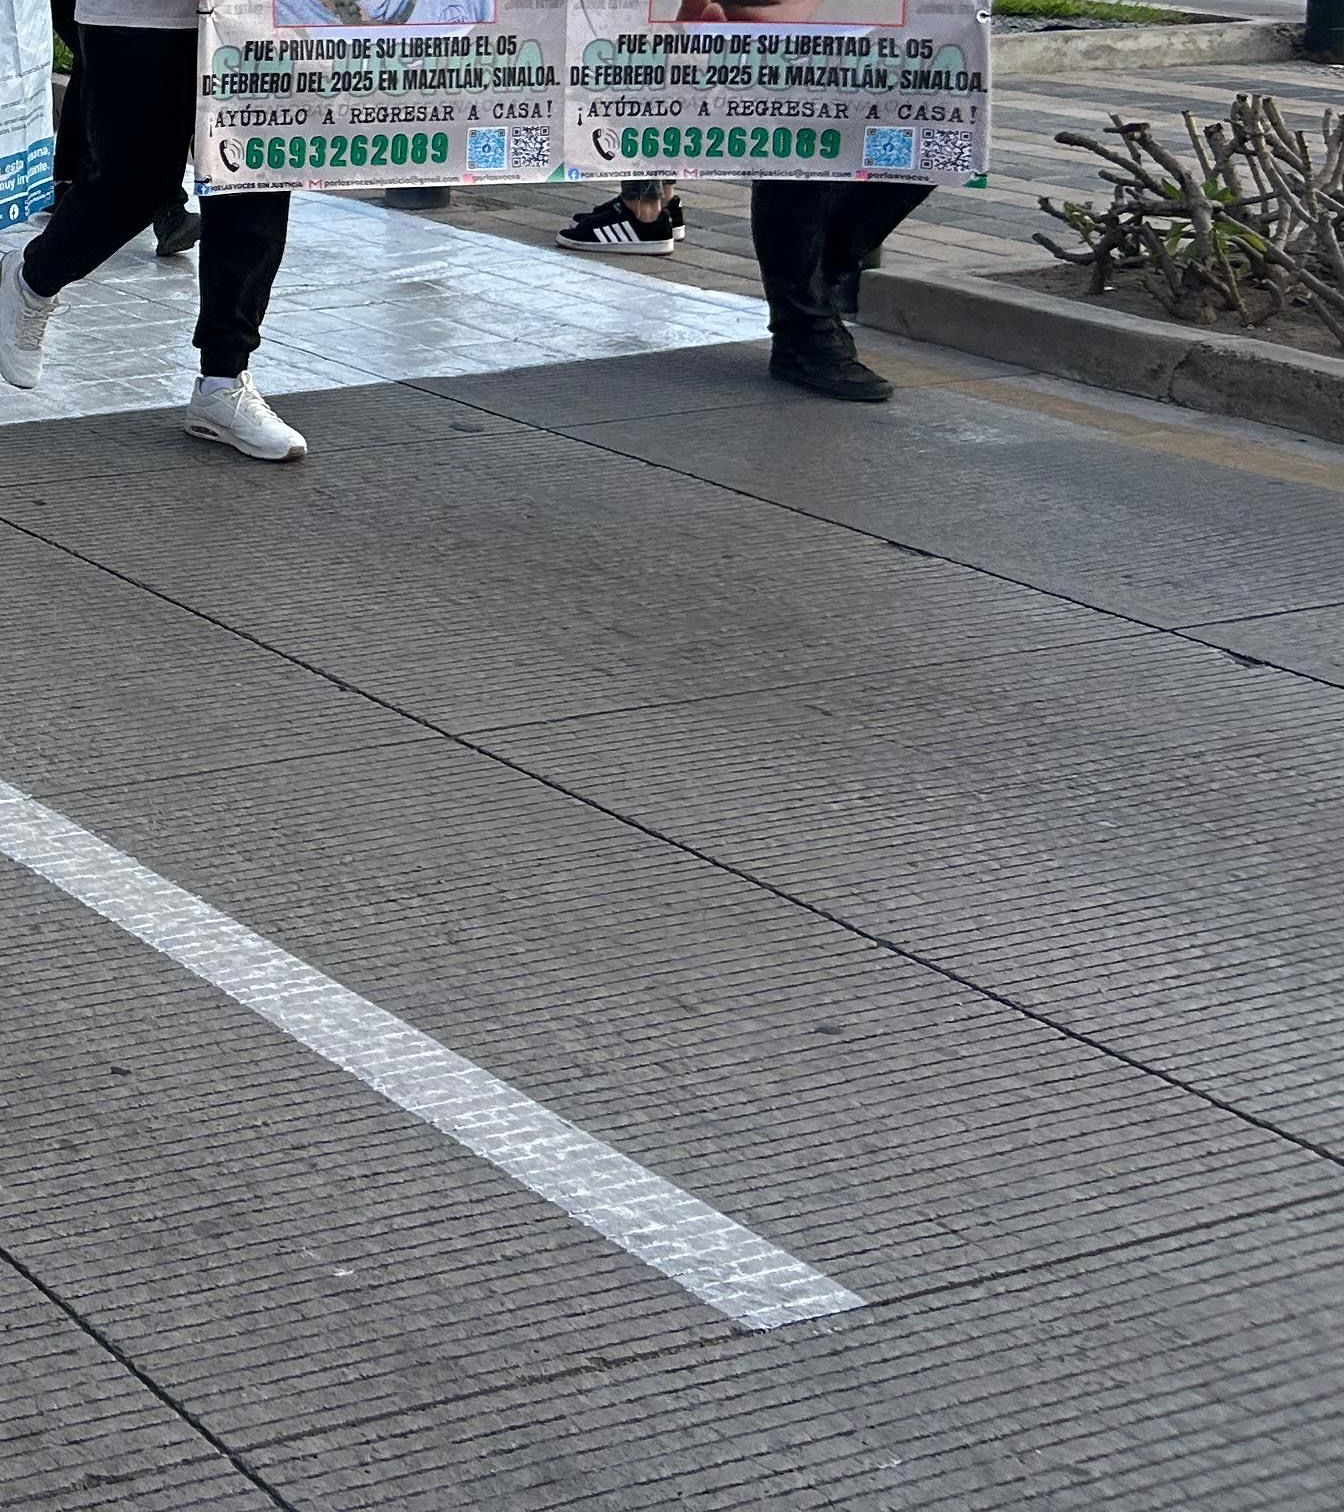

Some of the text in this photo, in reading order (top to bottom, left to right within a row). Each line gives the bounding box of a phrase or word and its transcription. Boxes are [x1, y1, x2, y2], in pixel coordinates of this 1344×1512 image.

[243, 35, 517, 63] FUE PRIVADO DE SU LIBERTAD EL 05
[220, 71, 292, 96] FEBRERO
[296, 70, 326, 94] DEL
[331, 69, 373, 93] 2025
[378, 68, 398, 91] EN
[402, 63, 490, 90] MAZATLÁN,
[492, 65, 561, 88] SINALOA.
[245, 131, 449, 170] 6693262089
[620, 126, 843, 160] 6693262089
